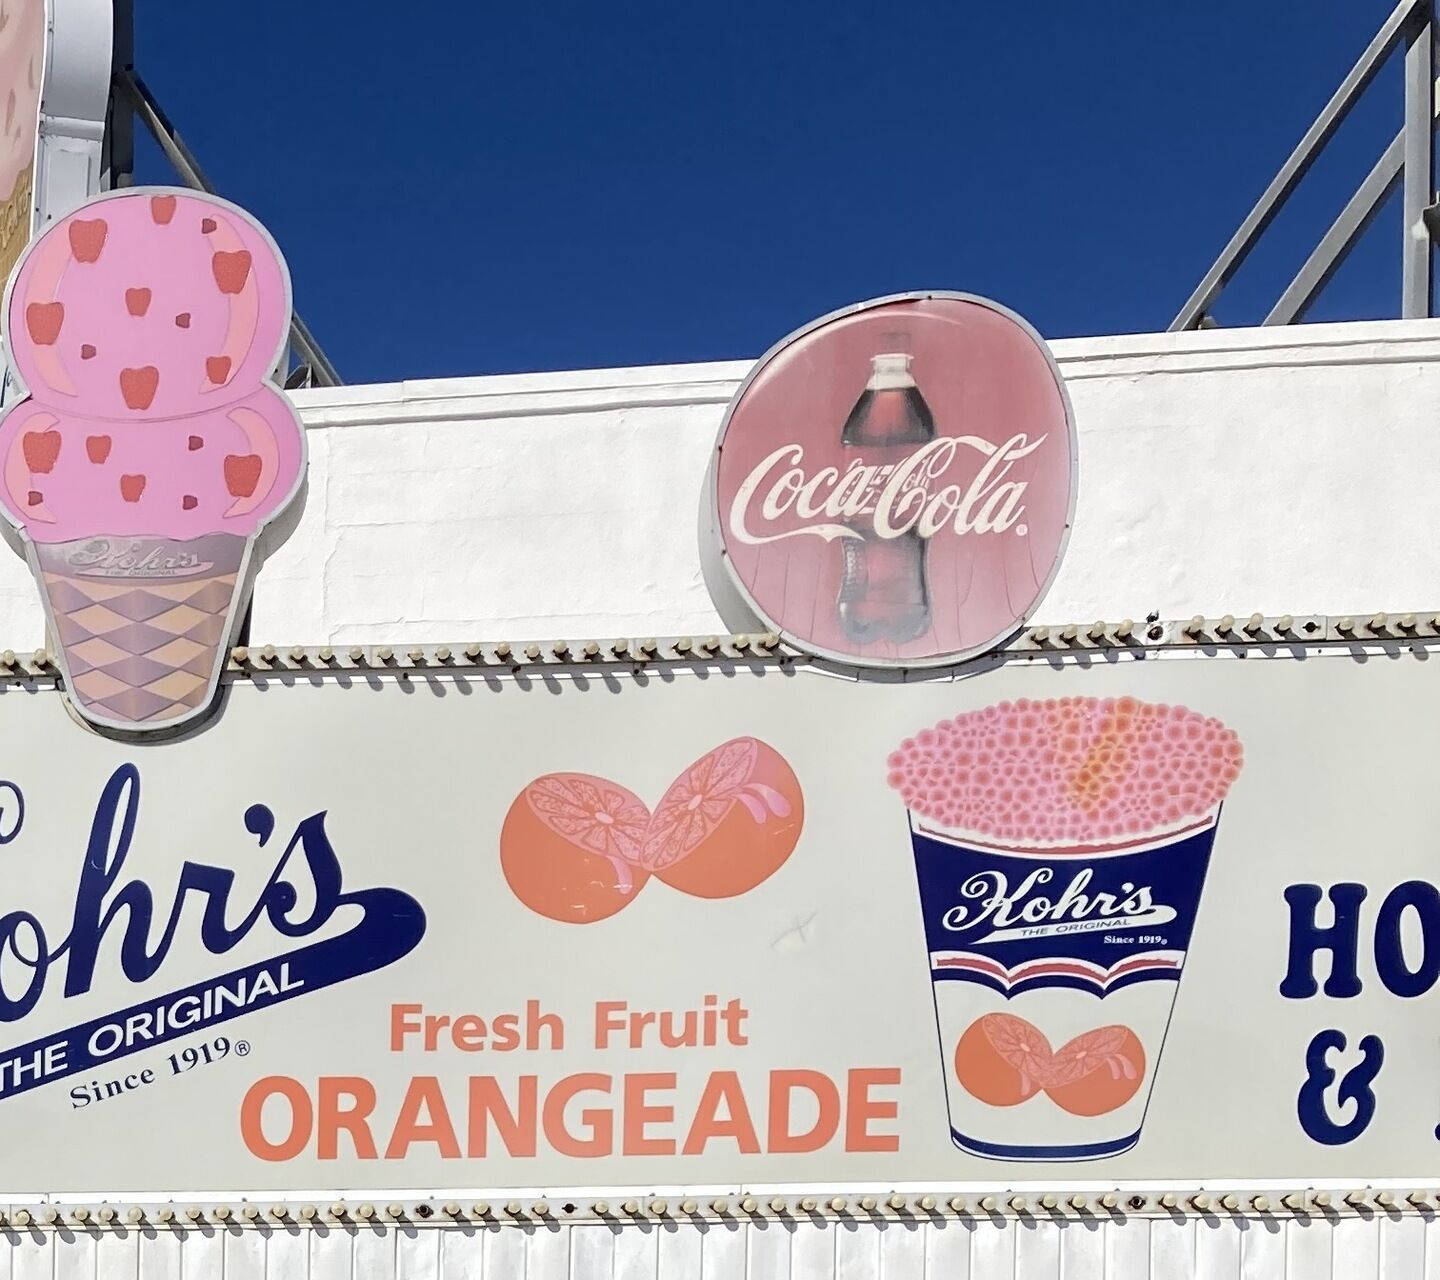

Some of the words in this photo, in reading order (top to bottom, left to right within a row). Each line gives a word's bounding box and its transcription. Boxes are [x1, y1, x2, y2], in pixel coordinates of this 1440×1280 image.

[942, 867, 1153, 931] Kohr's
[1020, 927, 1049, 937] THE
[1055, 917, 1131, 933] ORIGINAL
[1104, 935, 1135, 944] Since
[88, 962, 304, 1056] ORIGINAL
[391, 1001, 564, 1052] Fresh
[595, 995, 748, 1050] Fruit
[70, 1067, 155, 1110] Since
[240, 1067, 902, 1163] ORANGEADE
[1298, 1029, 1385, 1146] &
